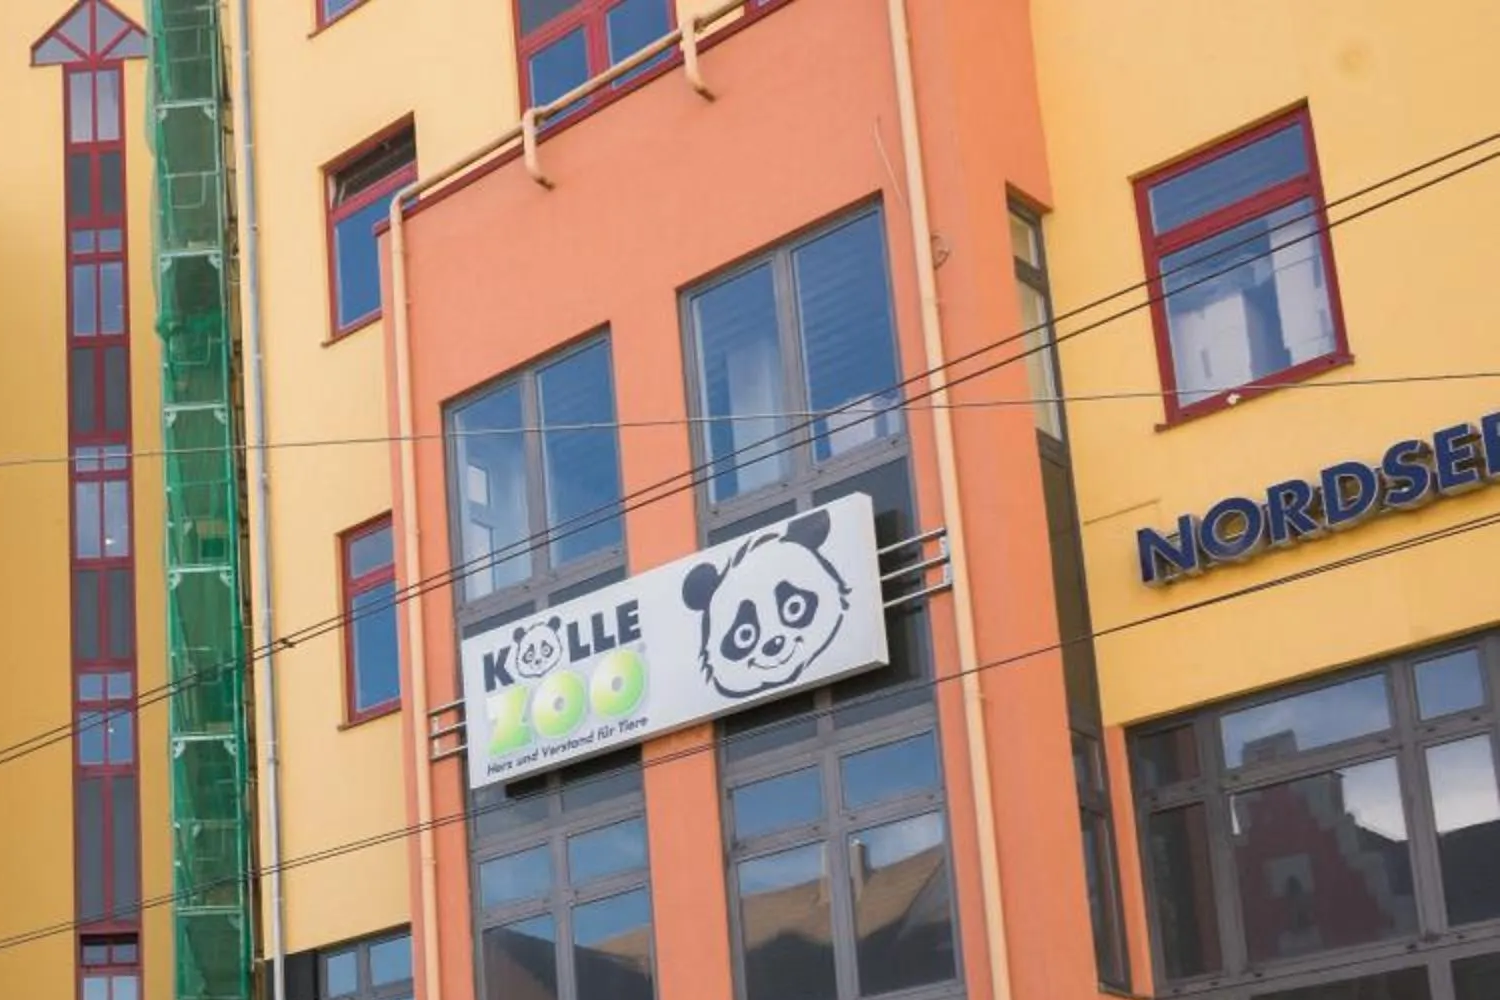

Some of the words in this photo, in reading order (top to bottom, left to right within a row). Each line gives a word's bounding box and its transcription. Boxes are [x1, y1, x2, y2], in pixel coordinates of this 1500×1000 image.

[486, 649, 647, 756] ZOO
[487, 759, 513, 775] Herz
[516, 750, 539, 766] und
[542, 731, 595, 757] Verstand
[598, 725, 615, 740] für
[619, 717, 648, 733] Tiere
